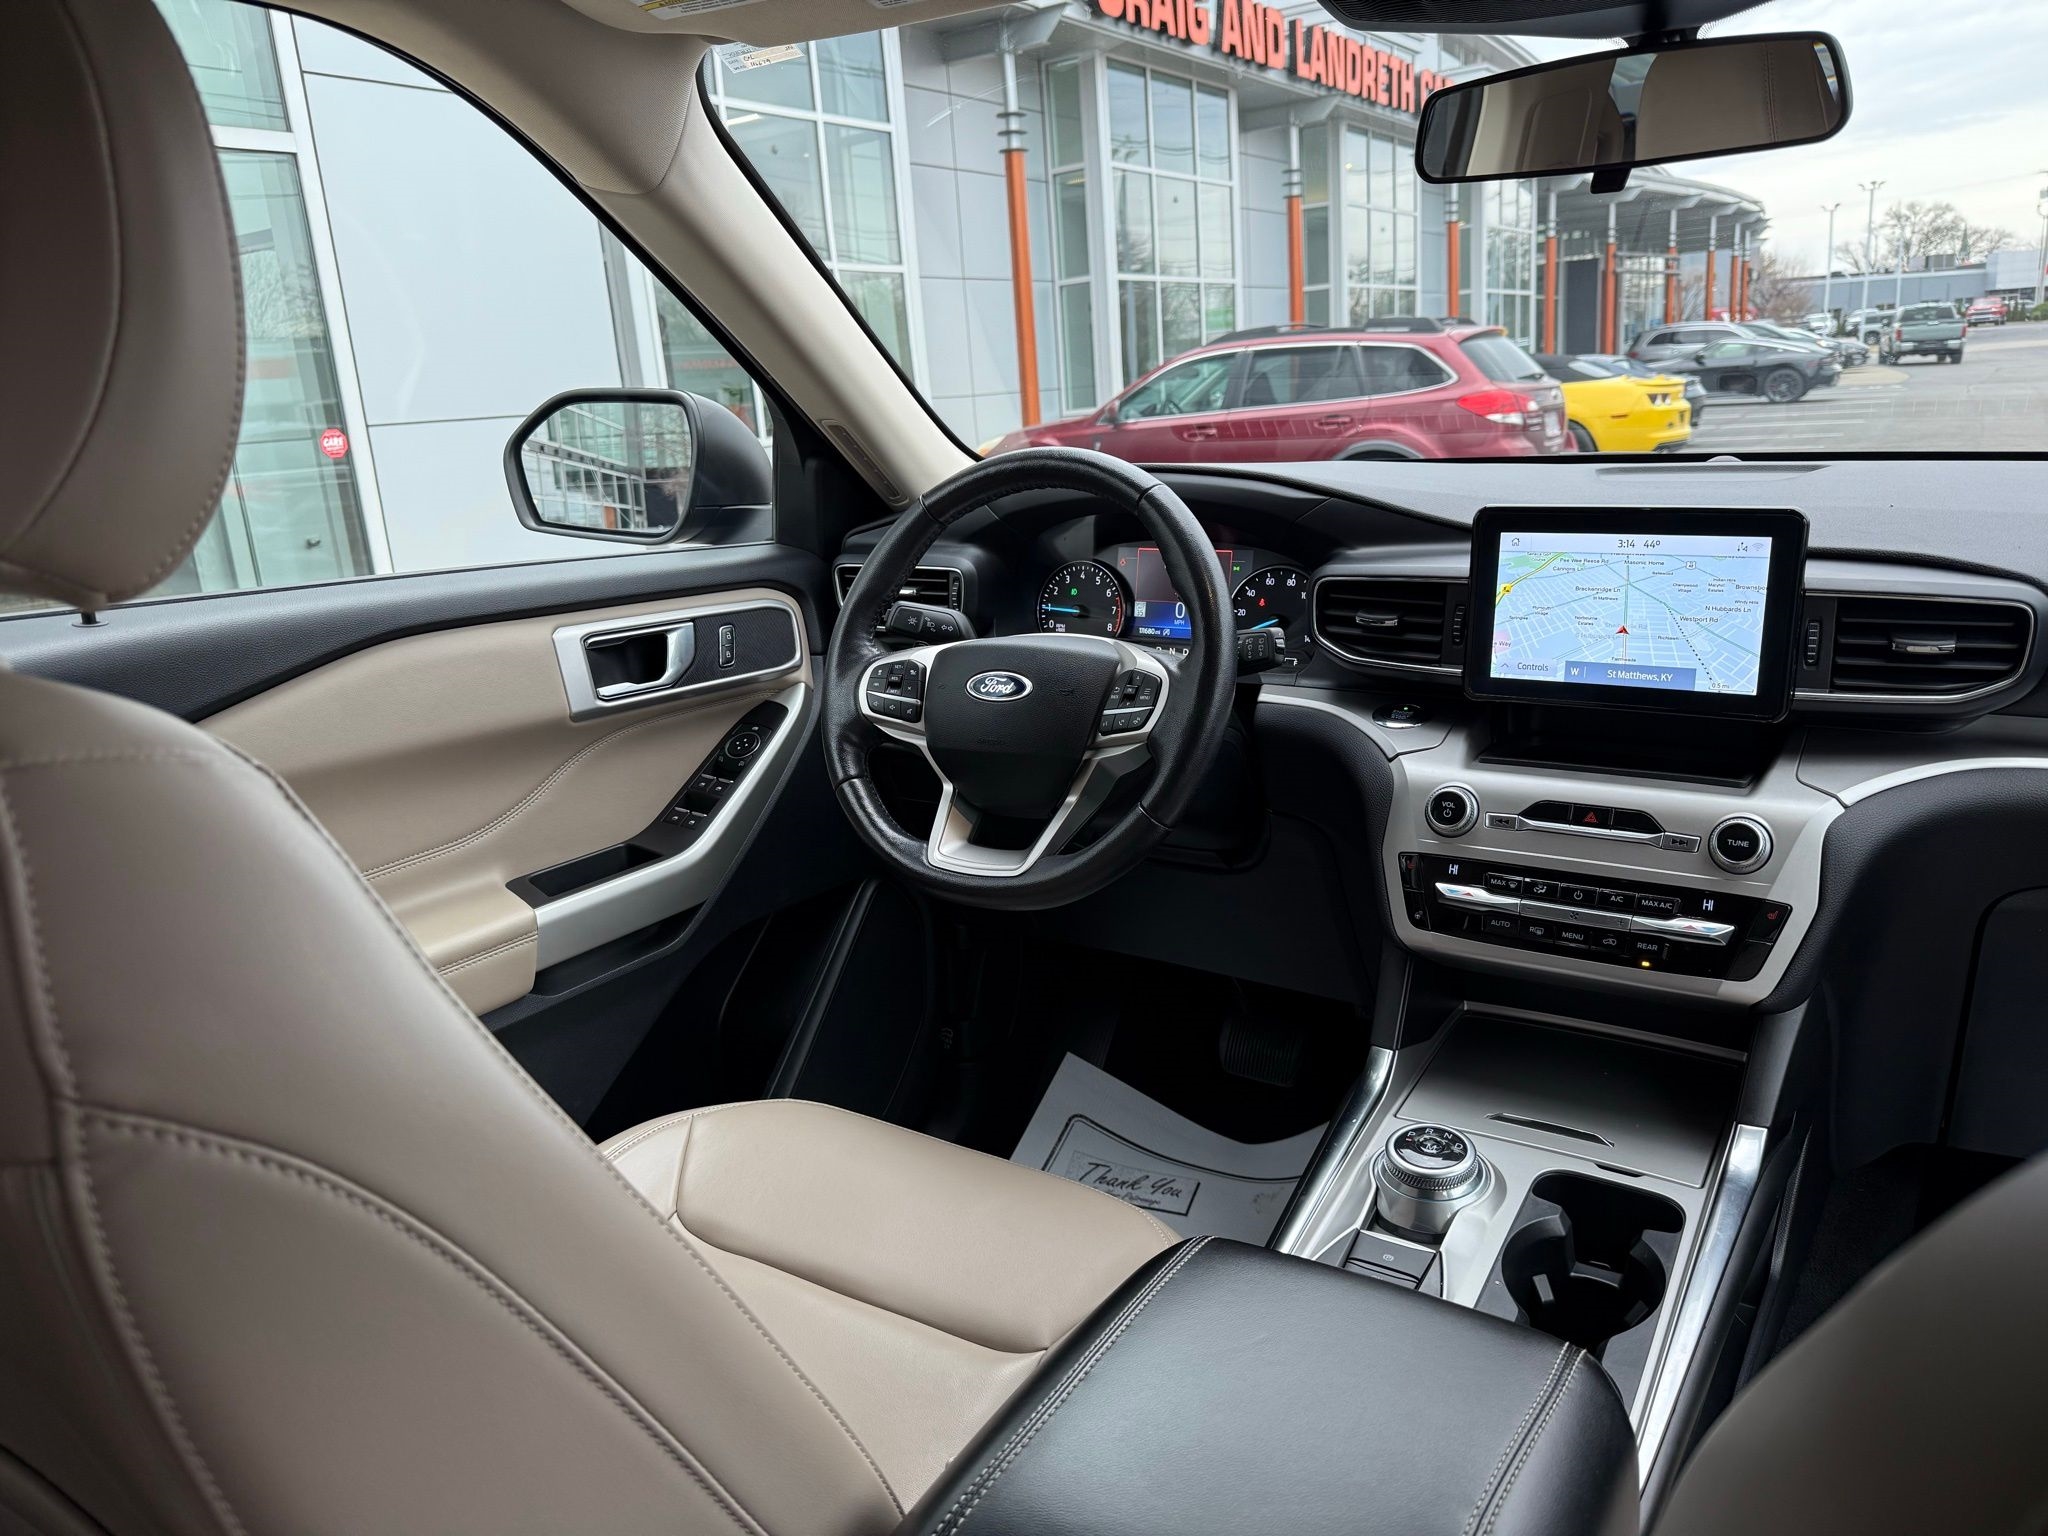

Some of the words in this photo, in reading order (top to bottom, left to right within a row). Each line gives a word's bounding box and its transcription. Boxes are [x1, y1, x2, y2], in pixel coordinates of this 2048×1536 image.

[1222, 0, 1286, 70] AND
[1295, 18, 1416, 113] LANDRETH
[1617, 539, 1635, 549] 3:14
[1065, 575, 1070, 584] 3
[1080, 571, 1086, 580] 4
[1095, 577, 1101, 585] 5
[1265, 577, 1275, 586] 60
[1286, 578, 1296, 587] 80
[1053, 587, 1059, 595] 2
[1106, 589, 1112, 597] 6
[1246, 589, 1256, 597] 40
[1111, 606, 1117, 615] 7
[1175, 601, 1186, 619] 0
[1237, 608, 1246, 616] 20
[1679, 615, 1708, 623] Westport
[1048, 620, 1054, 628] 0
[1107, 623, 1113, 632] 8
[1182, 648, 1190, 656] D
[1517, 662, 1549, 672] Controls
[1570, 667, 1580, 676] W
[1607, 670, 1617, 678] St
[1618, 670, 1659, 682] Matthews,
[1660, 673, 1673, 682] KY
[980, 676, 1015, 694] Ford
[1441, 801, 1456, 809] VOL
[1727, 839, 1750, 848] TUNE
[1448, 863, 1459, 875] HI
[1490, 878, 1507, 886] MAX
[1610, 895, 1624, 903] A/C
[1641, 899, 1659, 907] MAX
[1659, 901, 1673, 910] A/C
[1702, 899, 1714, 911] HI
[1490, 919, 1511, 928] AUTO
[1561, 931, 1584, 940] MENU
[1637, 942, 1658, 951] REAR
[1443, 1132, 1453, 1140] N
[1454, 1142, 1464, 1150] D
[1079, 1162, 1150, 1191] Thank
[1151, 1177, 1183, 1198] You
